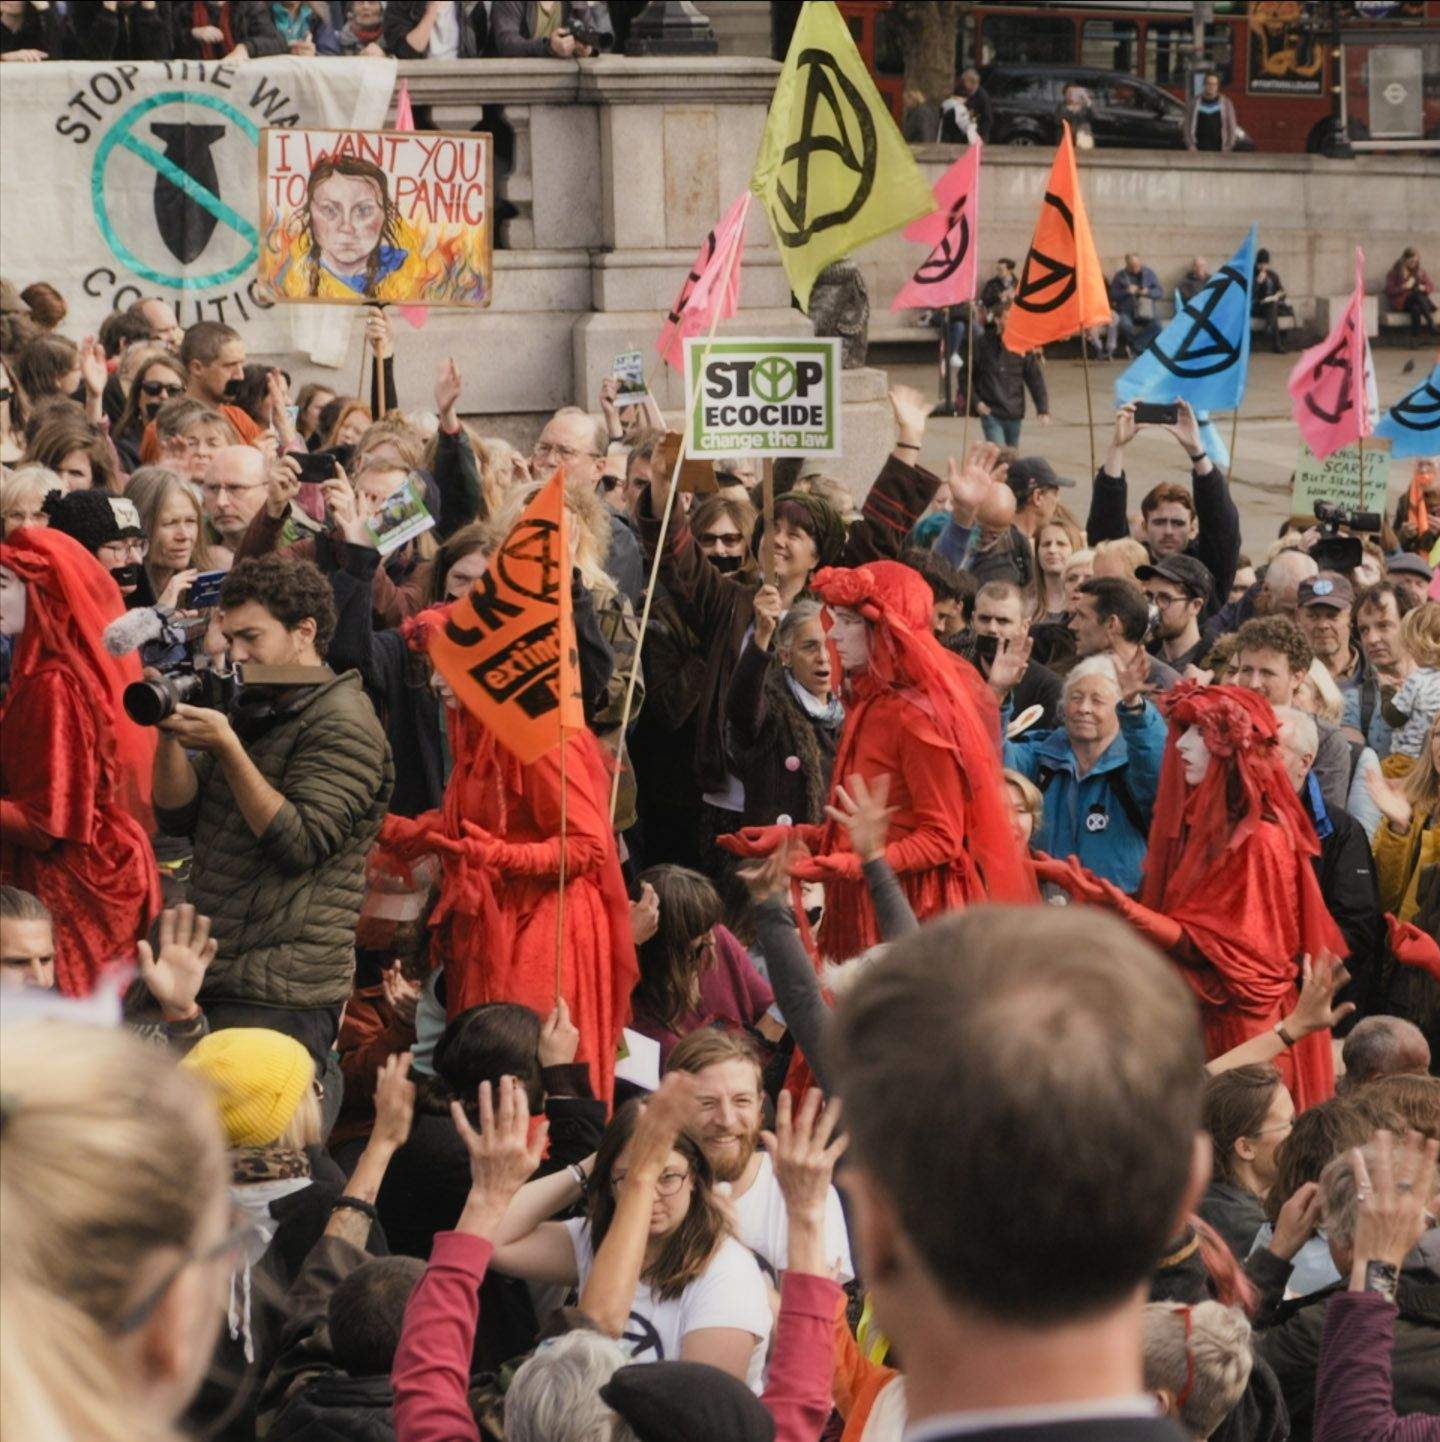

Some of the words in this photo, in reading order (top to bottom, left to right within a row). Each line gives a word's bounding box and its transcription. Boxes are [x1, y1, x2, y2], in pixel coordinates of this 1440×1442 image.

[55, 64, 139, 144] STOP
[249, 76, 300, 128] WA
[276, 134, 292, 172] I
[304, 132, 409, 174] WANT
[415, 137, 481, 184] YOU
[269, 174, 308, 207] TO
[394, 175, 483, 226] PANIC
[705, 356, 823, 402] STOP
[700, 432, 764, 450] change
[768, 430, 798, 447] the
[801, 431, 829, 447] law
[705, 405, 823, 427] ECOCIDE
